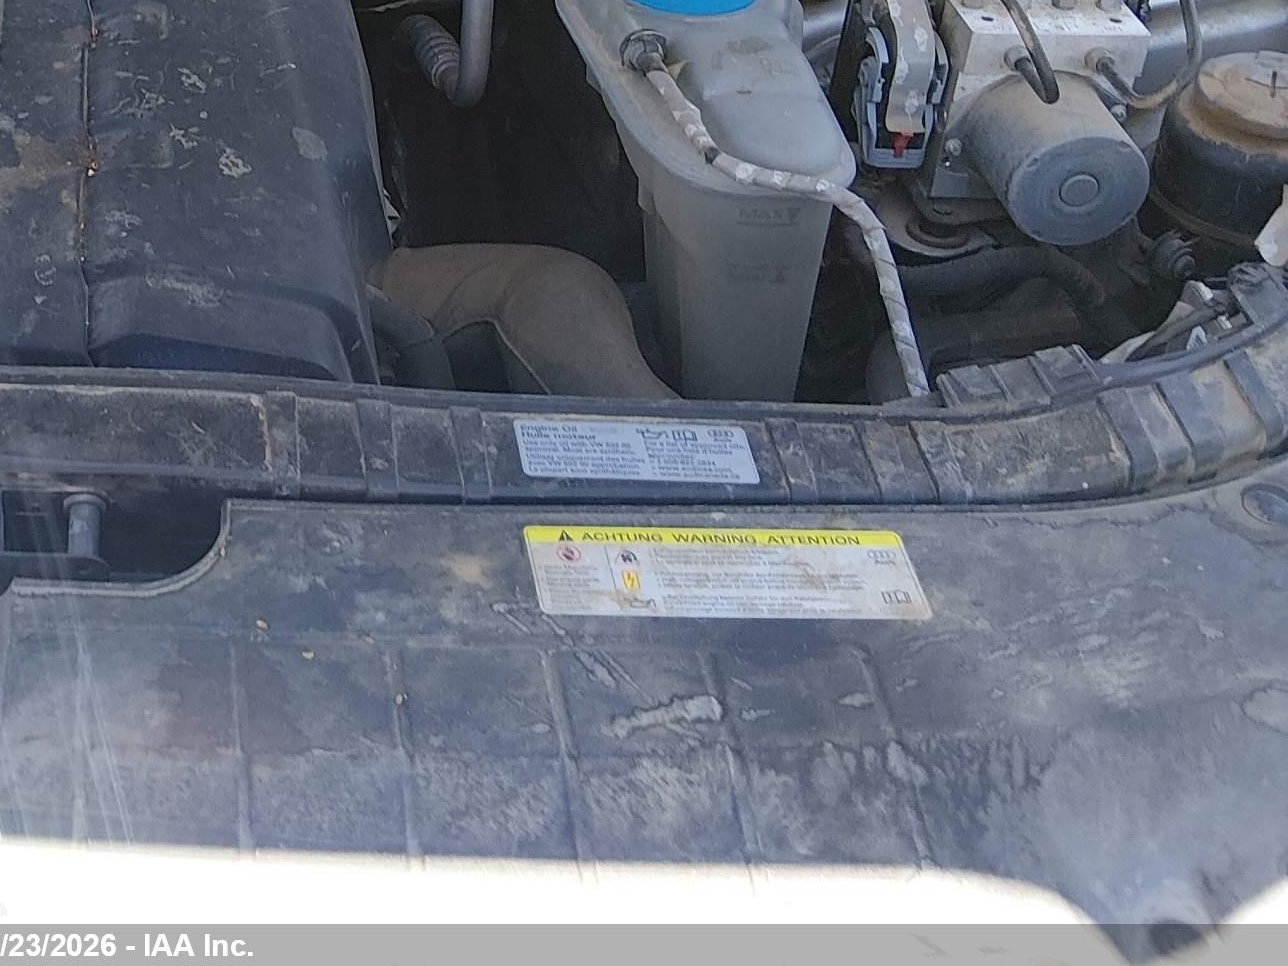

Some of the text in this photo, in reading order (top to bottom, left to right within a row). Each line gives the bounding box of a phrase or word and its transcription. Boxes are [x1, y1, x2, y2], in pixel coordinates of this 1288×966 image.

[520, 425, 559, 434] Engine
[562, 425, 578, 433] Oil
[581, 532, 861, 545] ACHTUNG WARNING ATTENTION
